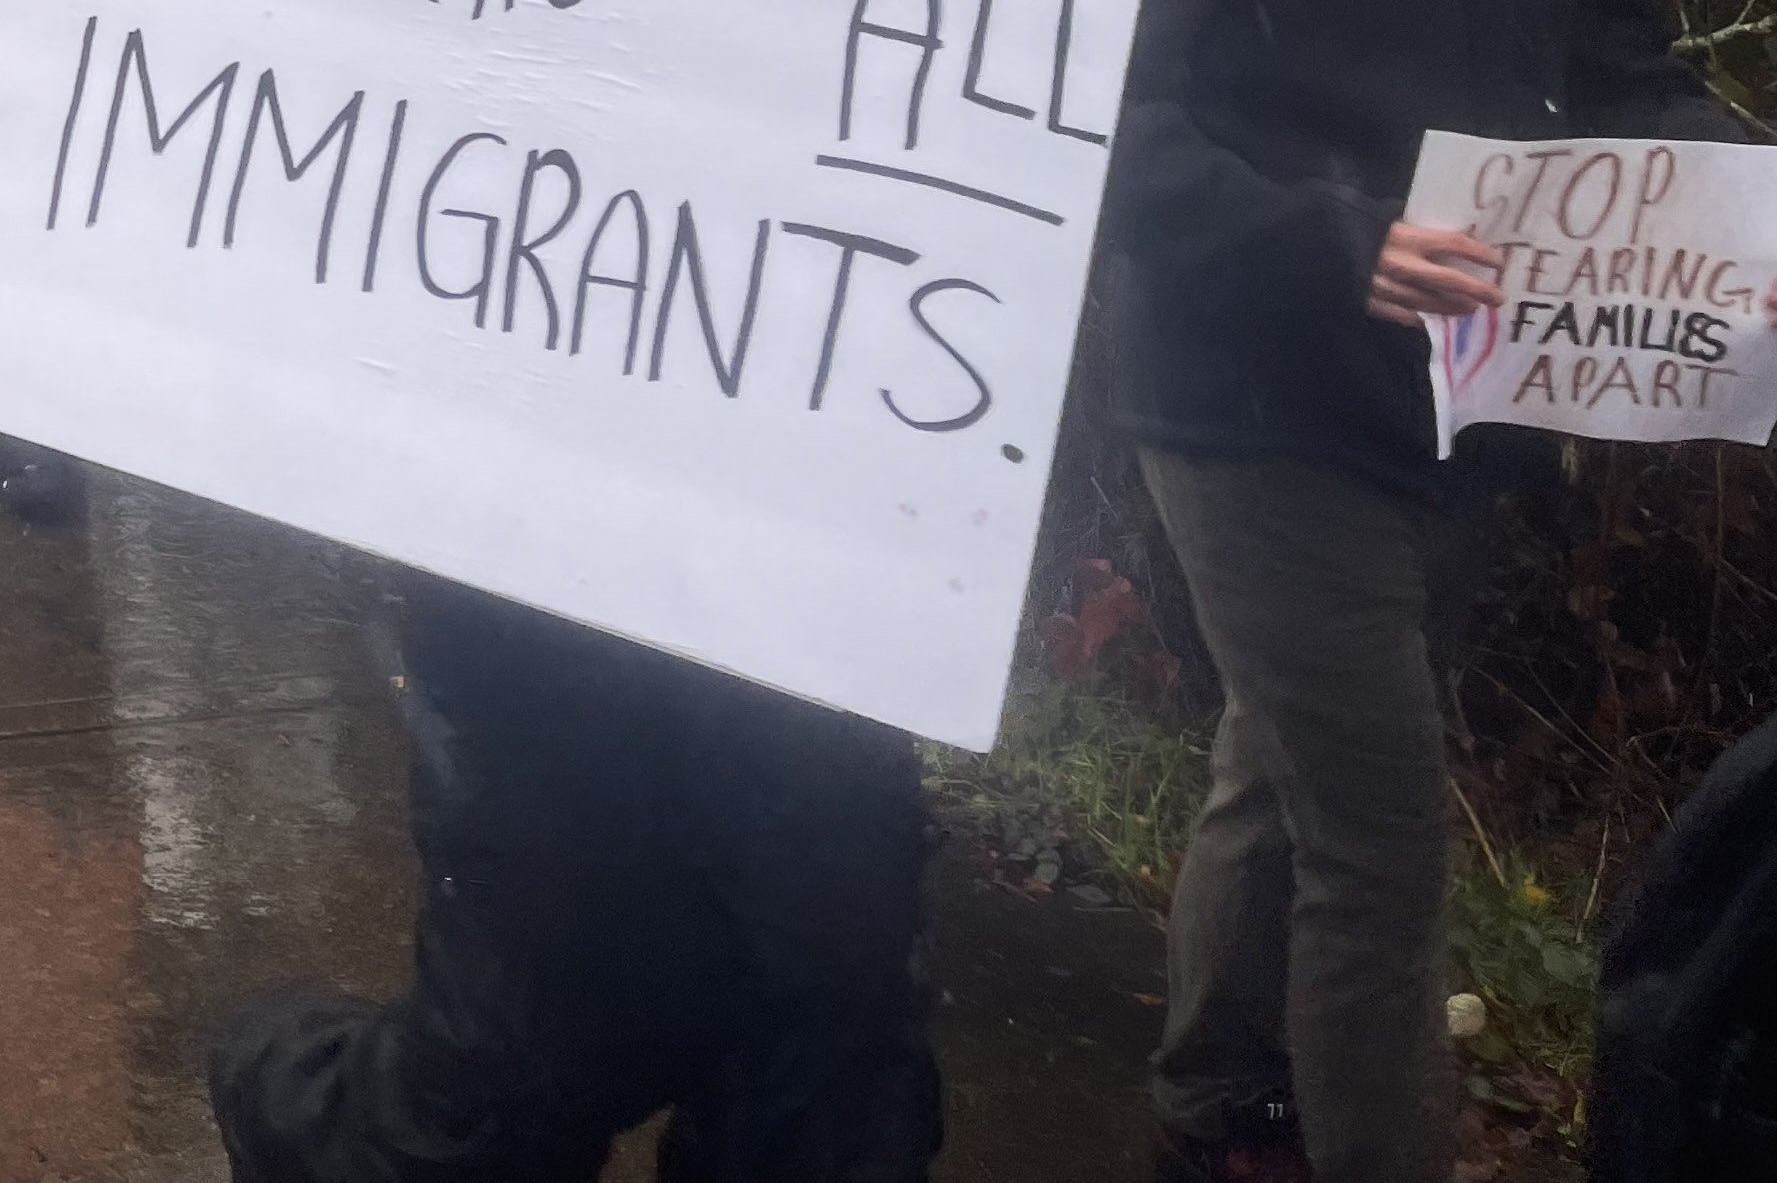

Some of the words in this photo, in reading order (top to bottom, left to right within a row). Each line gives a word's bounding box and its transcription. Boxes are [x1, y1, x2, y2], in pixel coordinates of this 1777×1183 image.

[1466, 146, 1675, 243] STOP
[45, 16, 1025, 464] IMMIGRANTS.
[1490, 241, 1755, 314] TEARING
[1512, 354, 1739, 410] APART
